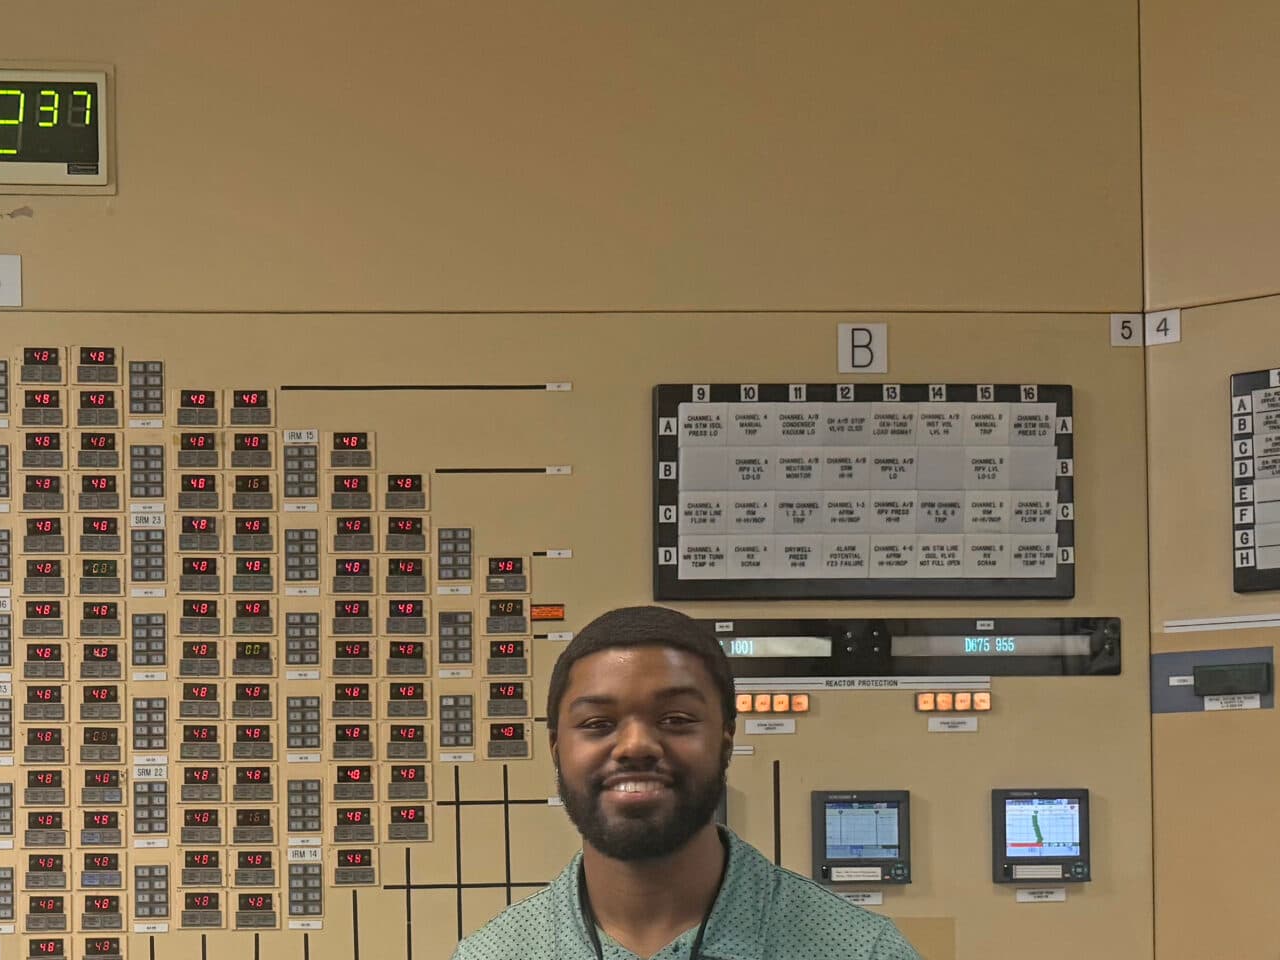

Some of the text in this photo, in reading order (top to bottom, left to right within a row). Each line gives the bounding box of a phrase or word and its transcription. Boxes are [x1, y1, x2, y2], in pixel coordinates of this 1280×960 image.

[38, 89, 92, 128] 37
[1120, 320, 1133, 340] 5
[1155, 317, 1170, 337] 4
[851, 327, 874, 369] B
[34, 351, 50, 362] 48
[90, 351, 106, 363] 48
[191, 394, 207, 405] 48
[696, 387, 706, 401] 9
[743, 386, 756, 400] 10
[793, 386, 802, 400] 11
[839, 386, 852, 400] 12
[885, 386, 898, 400] 13
[931, 386, 944, 400] 14
[980, 386, 992, 400] 15
[1023, 386, 1035, 401] 16
[1237, 398, 1247, 412] A
[663, 419, 673, 433] A
[1060, 418, 1069, 432] A
[1237, 417, 1247, 432] B
[288, 431, 314, 441] IRM 15
[343, 436, 359, 448] 48
[1238, 441, 1248, 455] C
[663, 463, 672, 478] B
[1060, 461, 1069, 475] B
[1239, 461, 1248, 476] D
[397, 478, 413, 489] 48
[1239, 486, 1249, 501] E
[663, 507, 672, 521] C
[1061, 505, 1070, 519] C
[1239, 508, 1249, 522] F
[135, 515, 162, 525] SRM 23
[1239, 531, 1249, 545] G
[663, 549, 672, 563] D
[1061, 548, 1070, 562] D
[1240, 551, 1250, 566] H
[499, 561, 514, 571] 48
[996, 638, 1015, 652] 955
[0, 684, 8, 694] 13
[825, 679, 899, 687] REACTOR PROTECTION
[245, 686, 262, 698] 48
[399, 686, 415, 697] 48
[137, 767, 163, 777] SRM 22
[291, 849, 318, 859] IRM 14
[40, 942, 56, 953] 48
